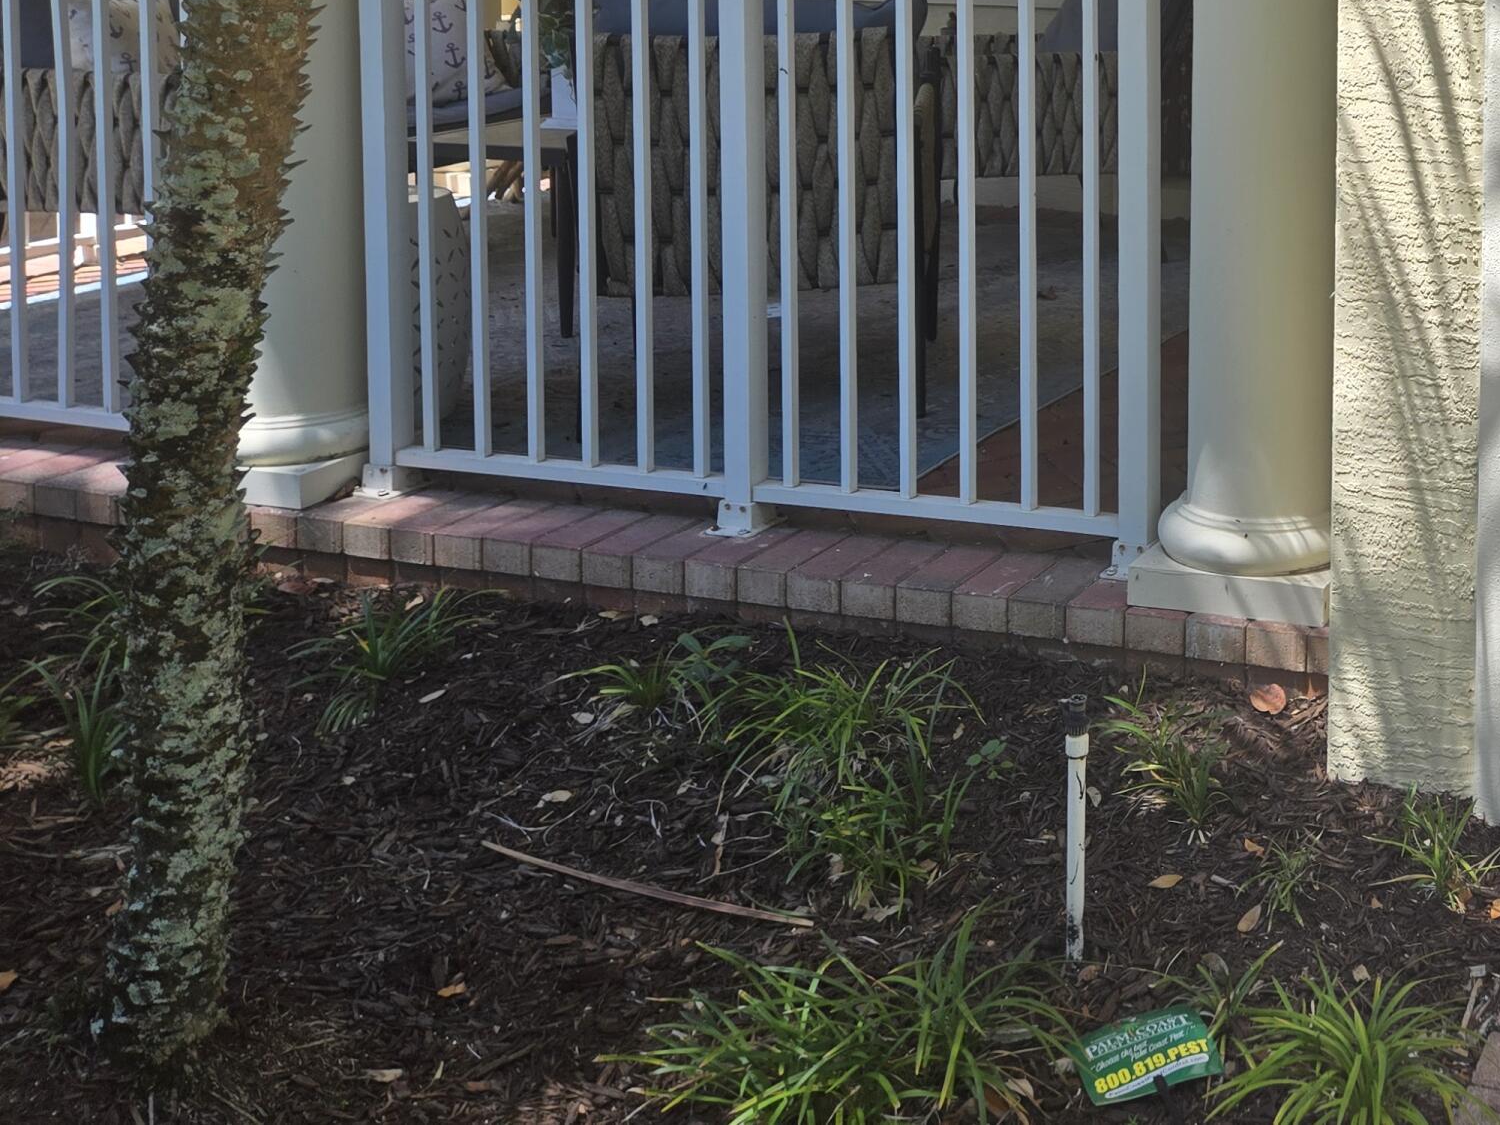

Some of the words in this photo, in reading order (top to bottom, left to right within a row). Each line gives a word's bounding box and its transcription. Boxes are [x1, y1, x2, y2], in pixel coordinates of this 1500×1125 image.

[1085, 1031, 1132, 1061] PALM
[1137, 1013, 1193, 1039] COAST
[1094, 1038, 1209, 1094] 800.819.PEST
